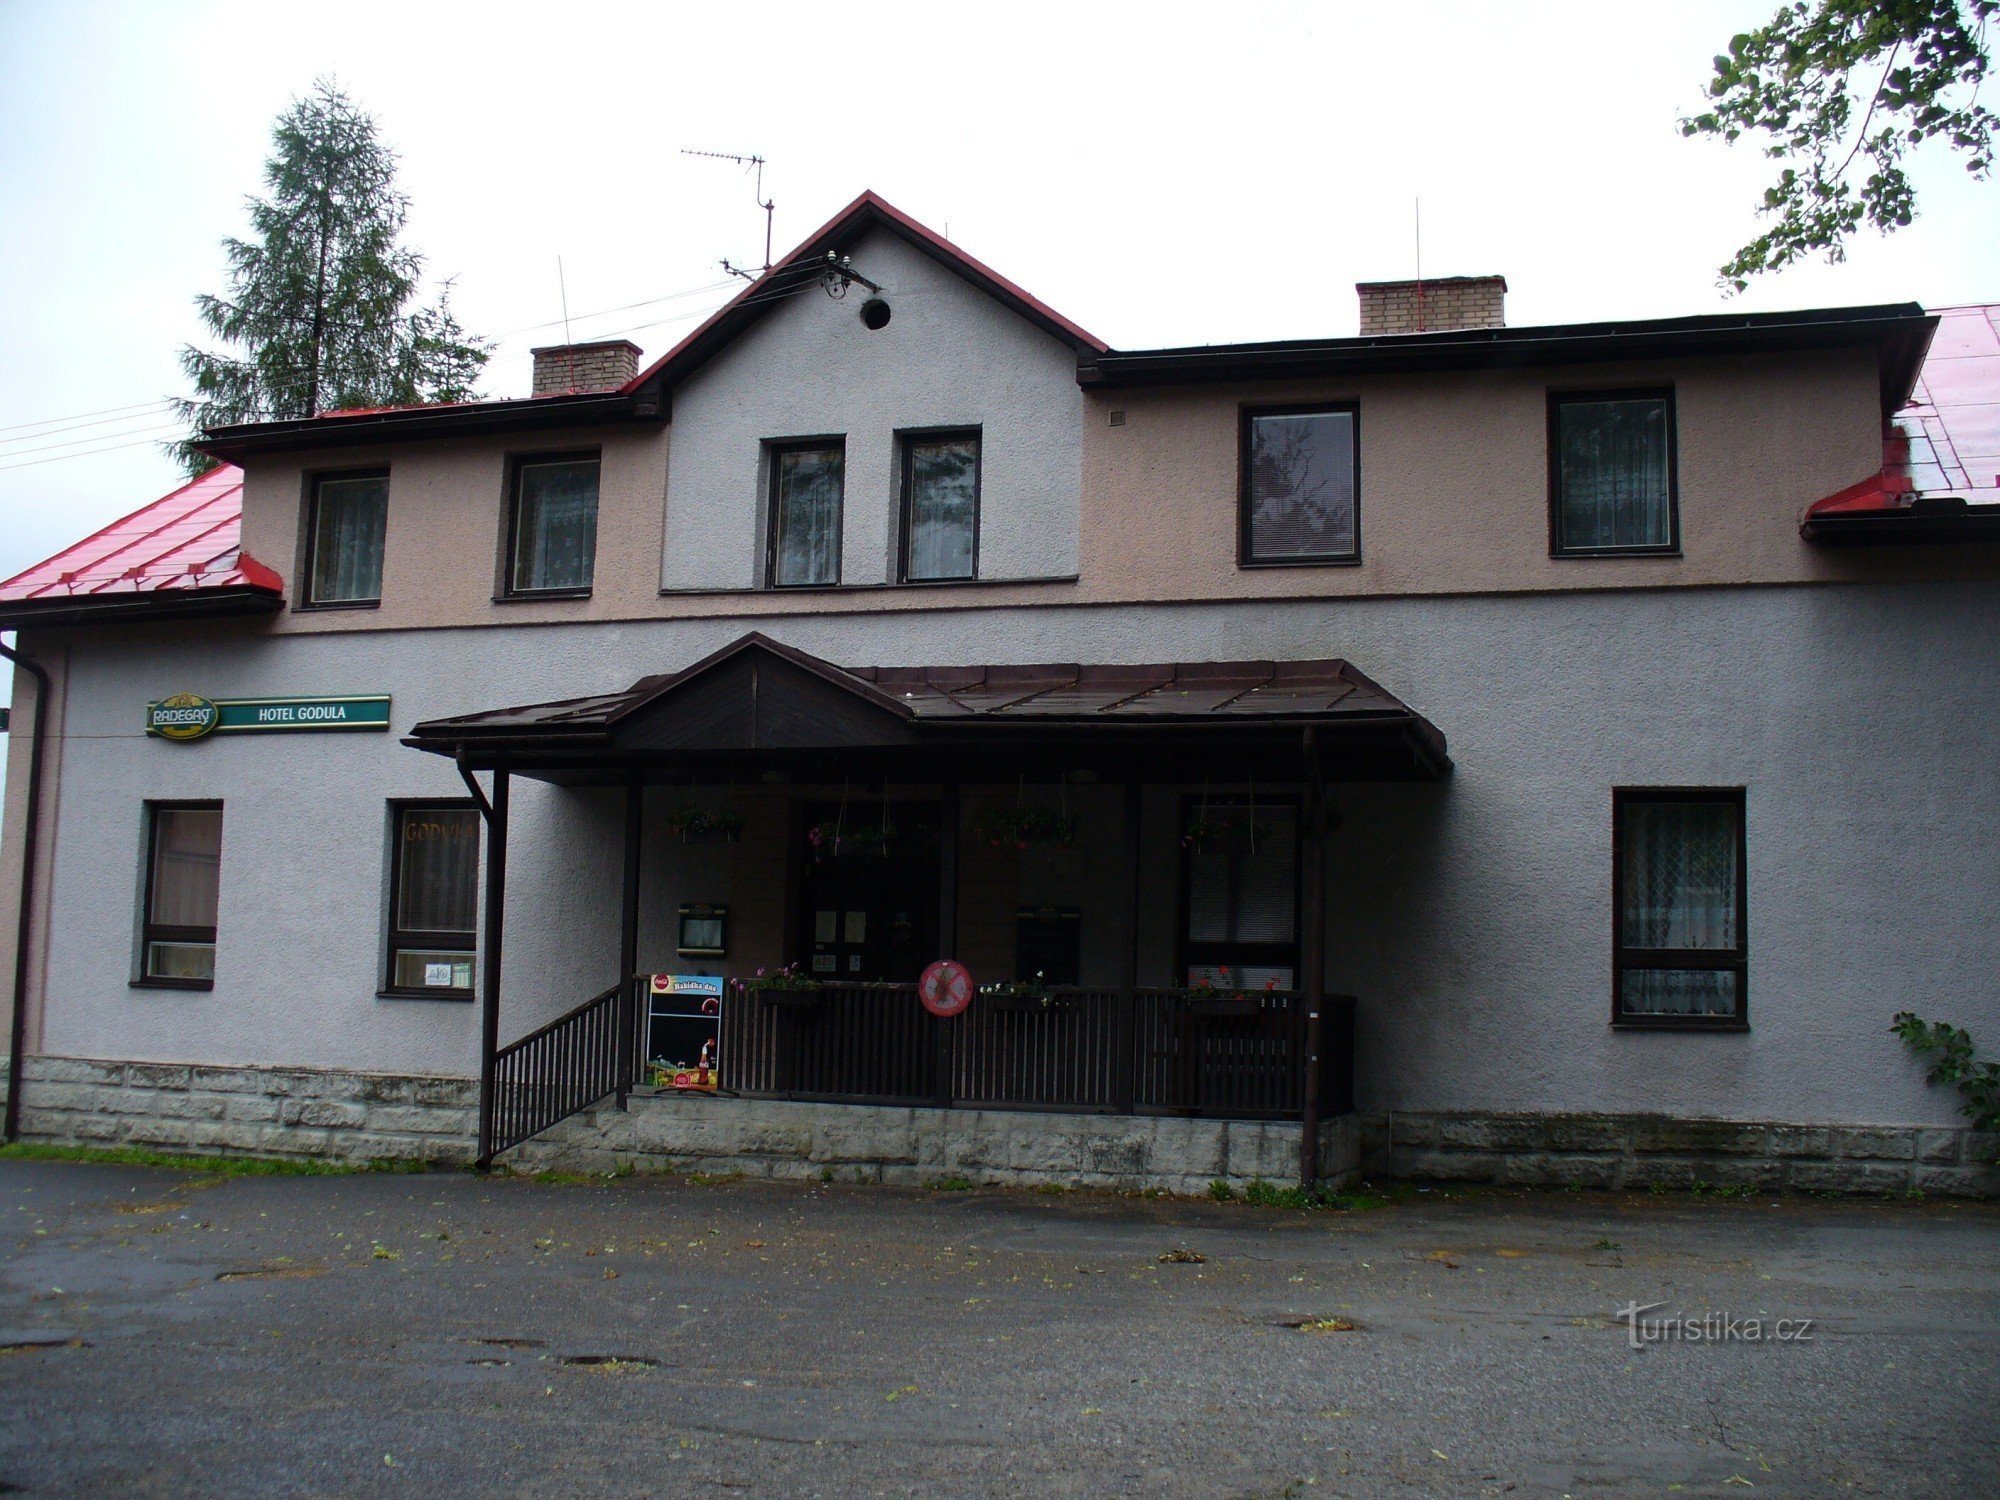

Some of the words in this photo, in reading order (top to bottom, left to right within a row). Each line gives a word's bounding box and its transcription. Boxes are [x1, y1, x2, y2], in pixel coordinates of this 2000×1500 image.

[153, 708, 211, 726] RADEGAST
[259, 708, 295, 721] HOTEL
[298, 706, 346, 720] GODULA
